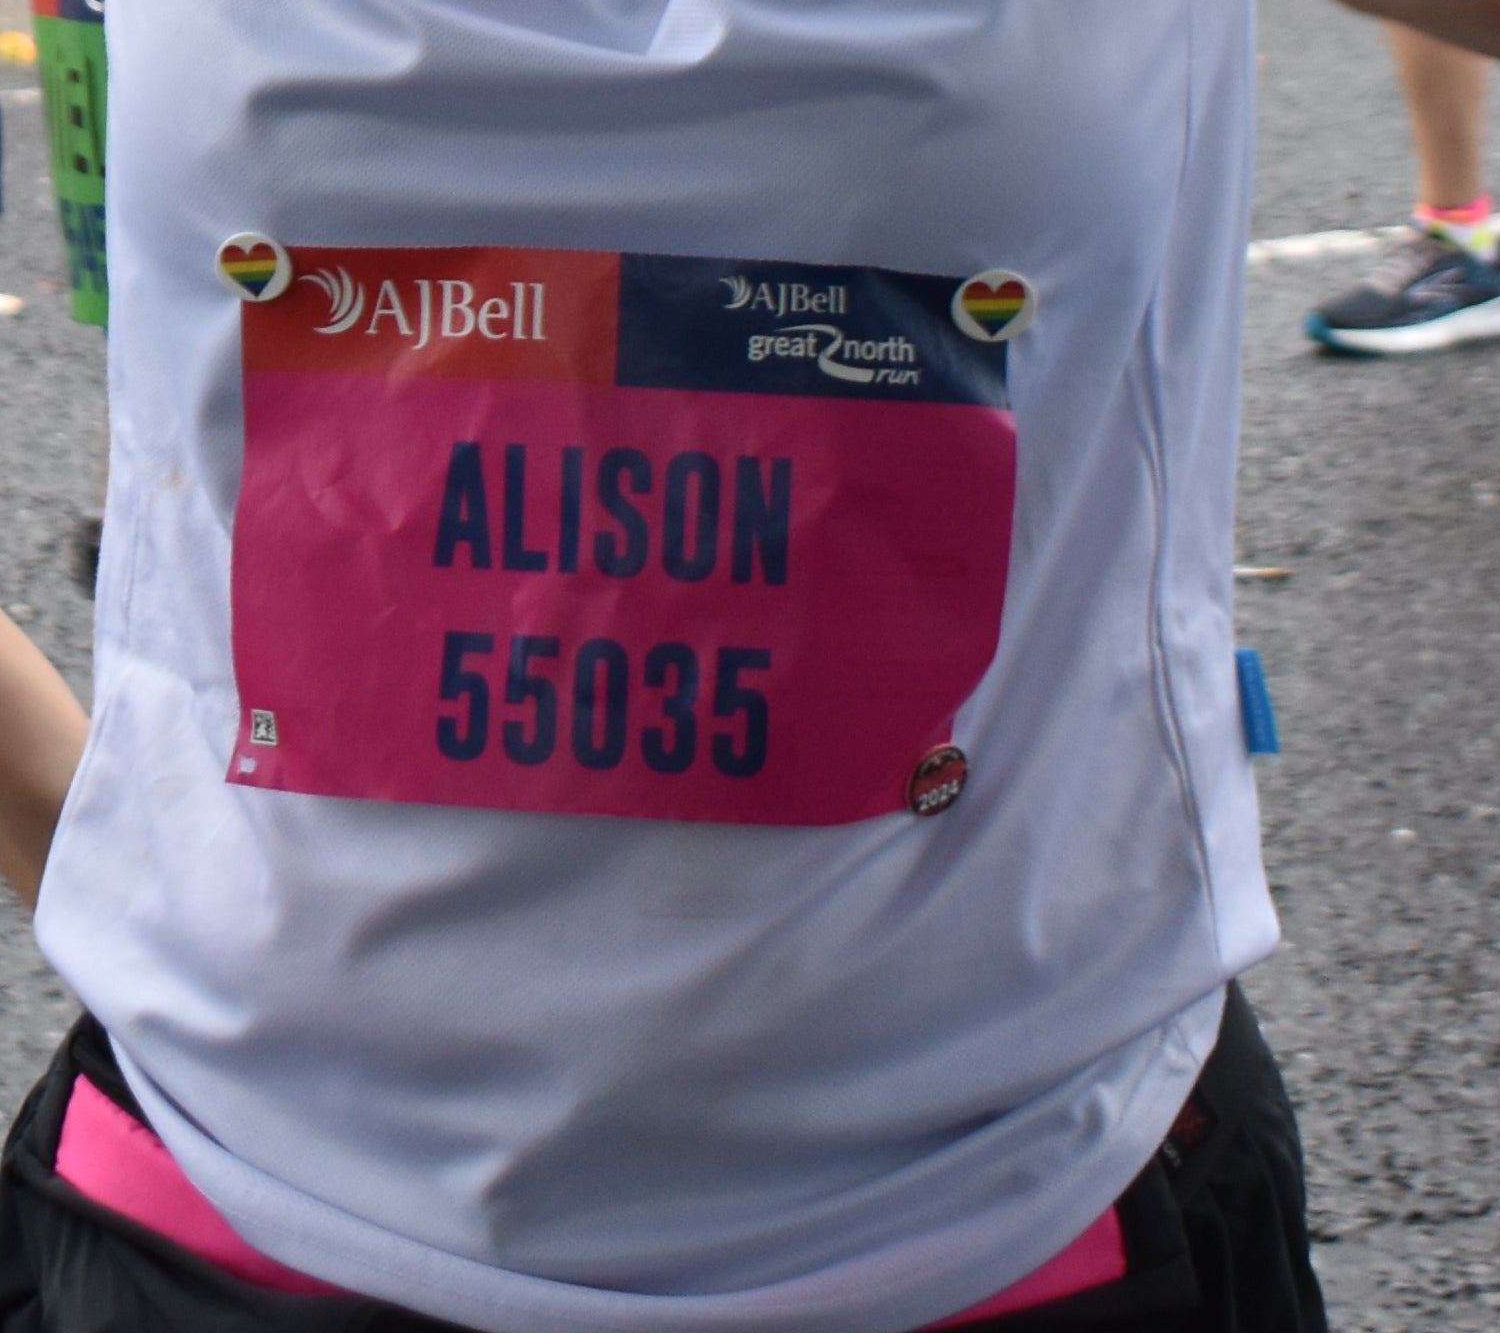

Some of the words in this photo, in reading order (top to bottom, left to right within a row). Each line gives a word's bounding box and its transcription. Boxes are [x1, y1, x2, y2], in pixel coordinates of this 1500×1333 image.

[748, 333, 818, 362] great
[843, 336, 916, 363] north
[875, 368, 922, 385] run
[431, 440, 794, 586] ALISON
[434, 630, 773, 779] 55035
